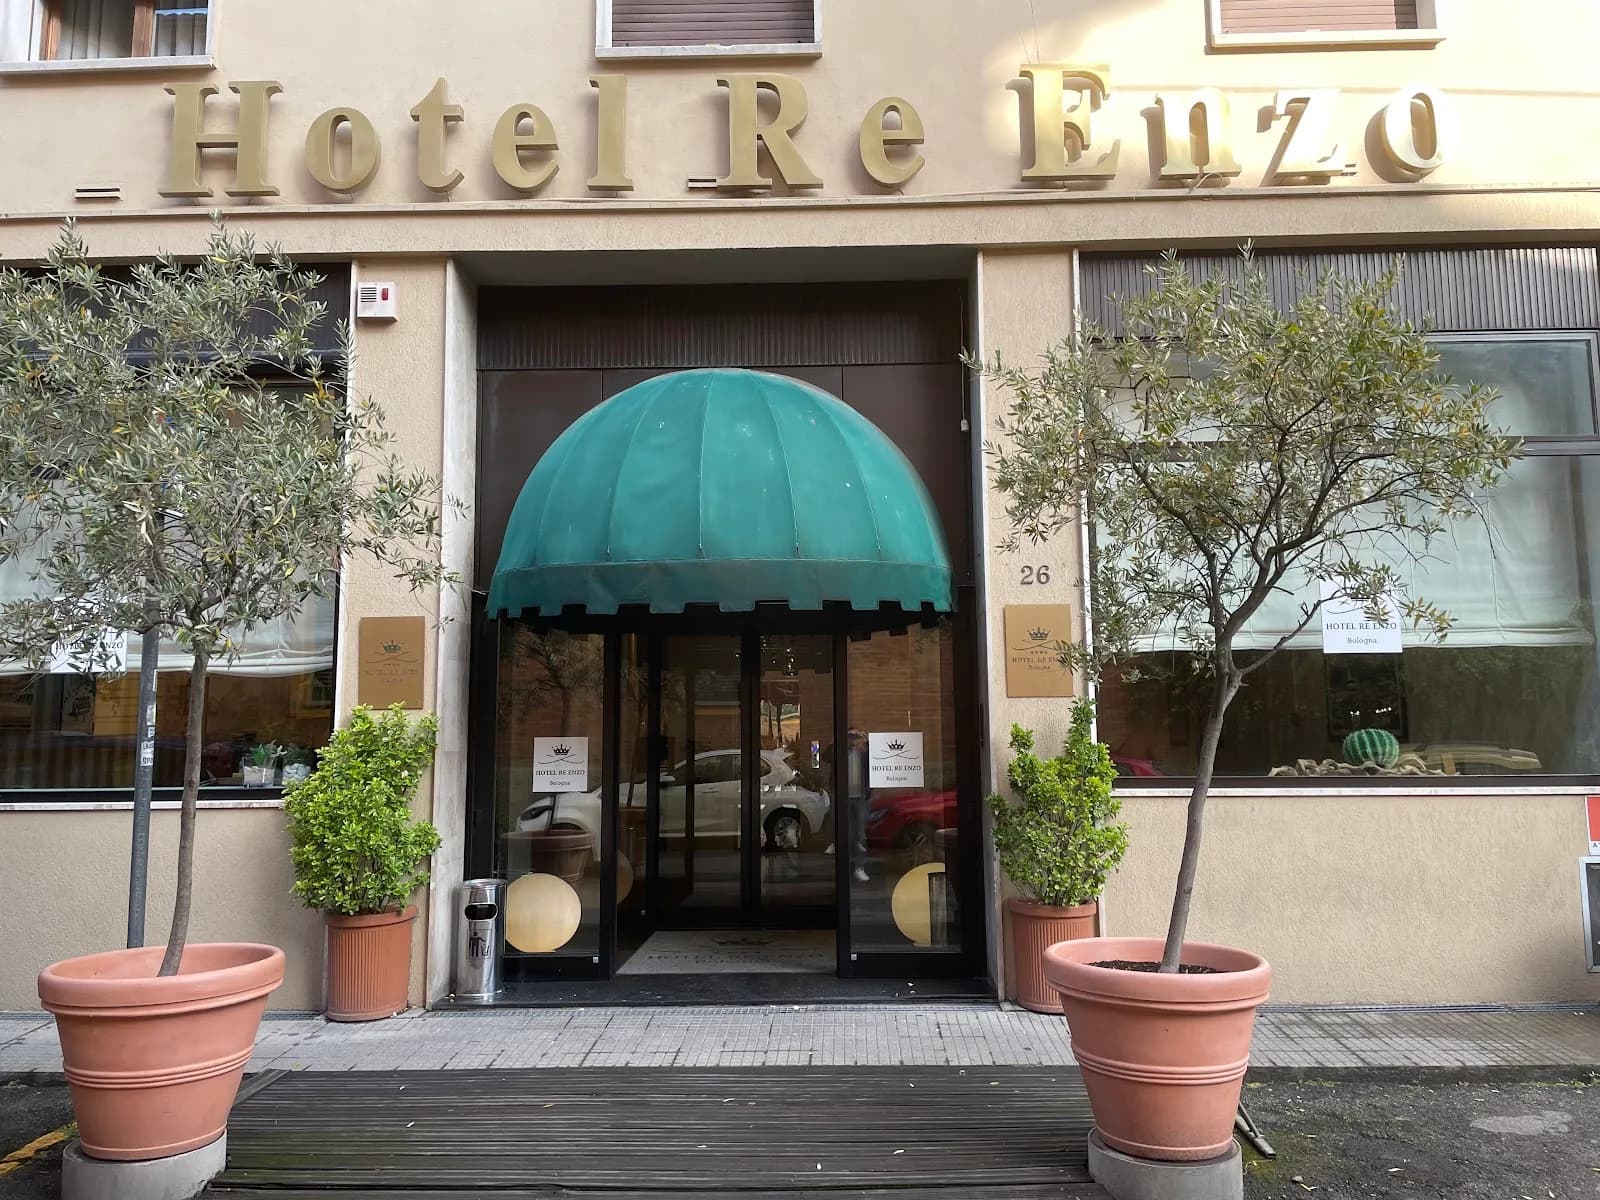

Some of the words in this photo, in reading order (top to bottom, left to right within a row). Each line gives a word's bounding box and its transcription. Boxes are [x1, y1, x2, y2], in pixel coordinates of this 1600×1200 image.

[158, 73, 634, 198] Hotel
[716, 72, 926, 190] Re
[1012, 64, 1446, 188] Enzo
[1020, 565, 1051, 585] 26
[1326, 622, 1356, 630] HOTEL
[1359, 622, 1371, 630] RE
[1347, 637, 1377, 645] Bologna
